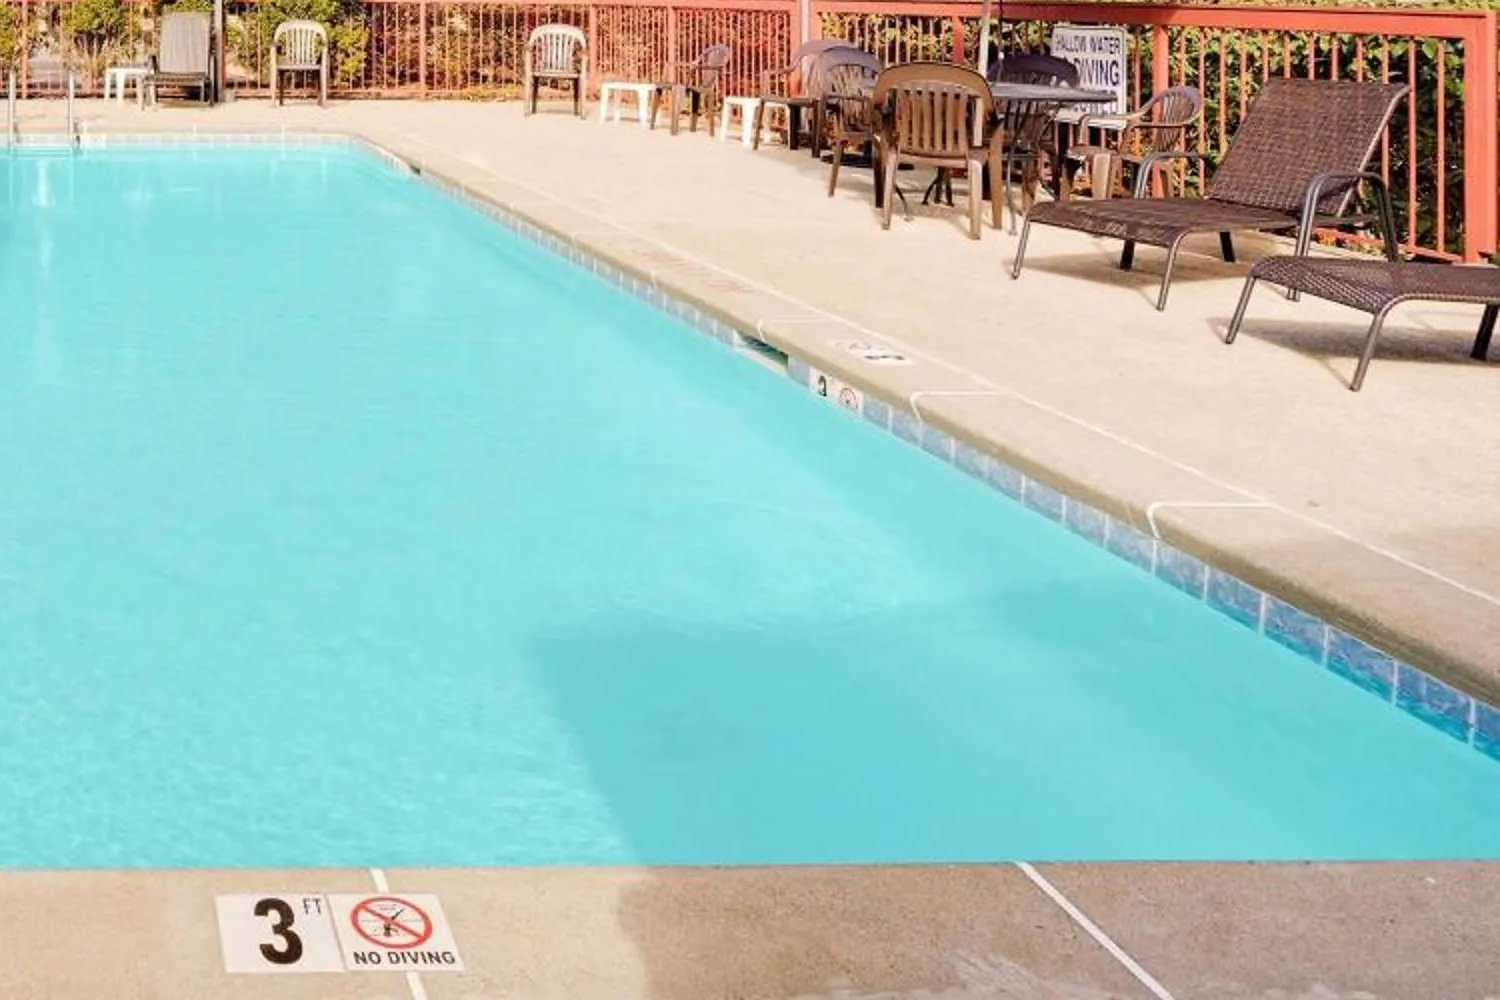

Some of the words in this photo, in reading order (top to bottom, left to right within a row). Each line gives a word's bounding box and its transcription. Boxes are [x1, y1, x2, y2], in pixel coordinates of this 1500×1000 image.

[253, 897, 303, 965] 3
[302, 898, 322, 915] FT
[353, 951, 382, 966] NO
[387, 951, 456, 966] DIVING
